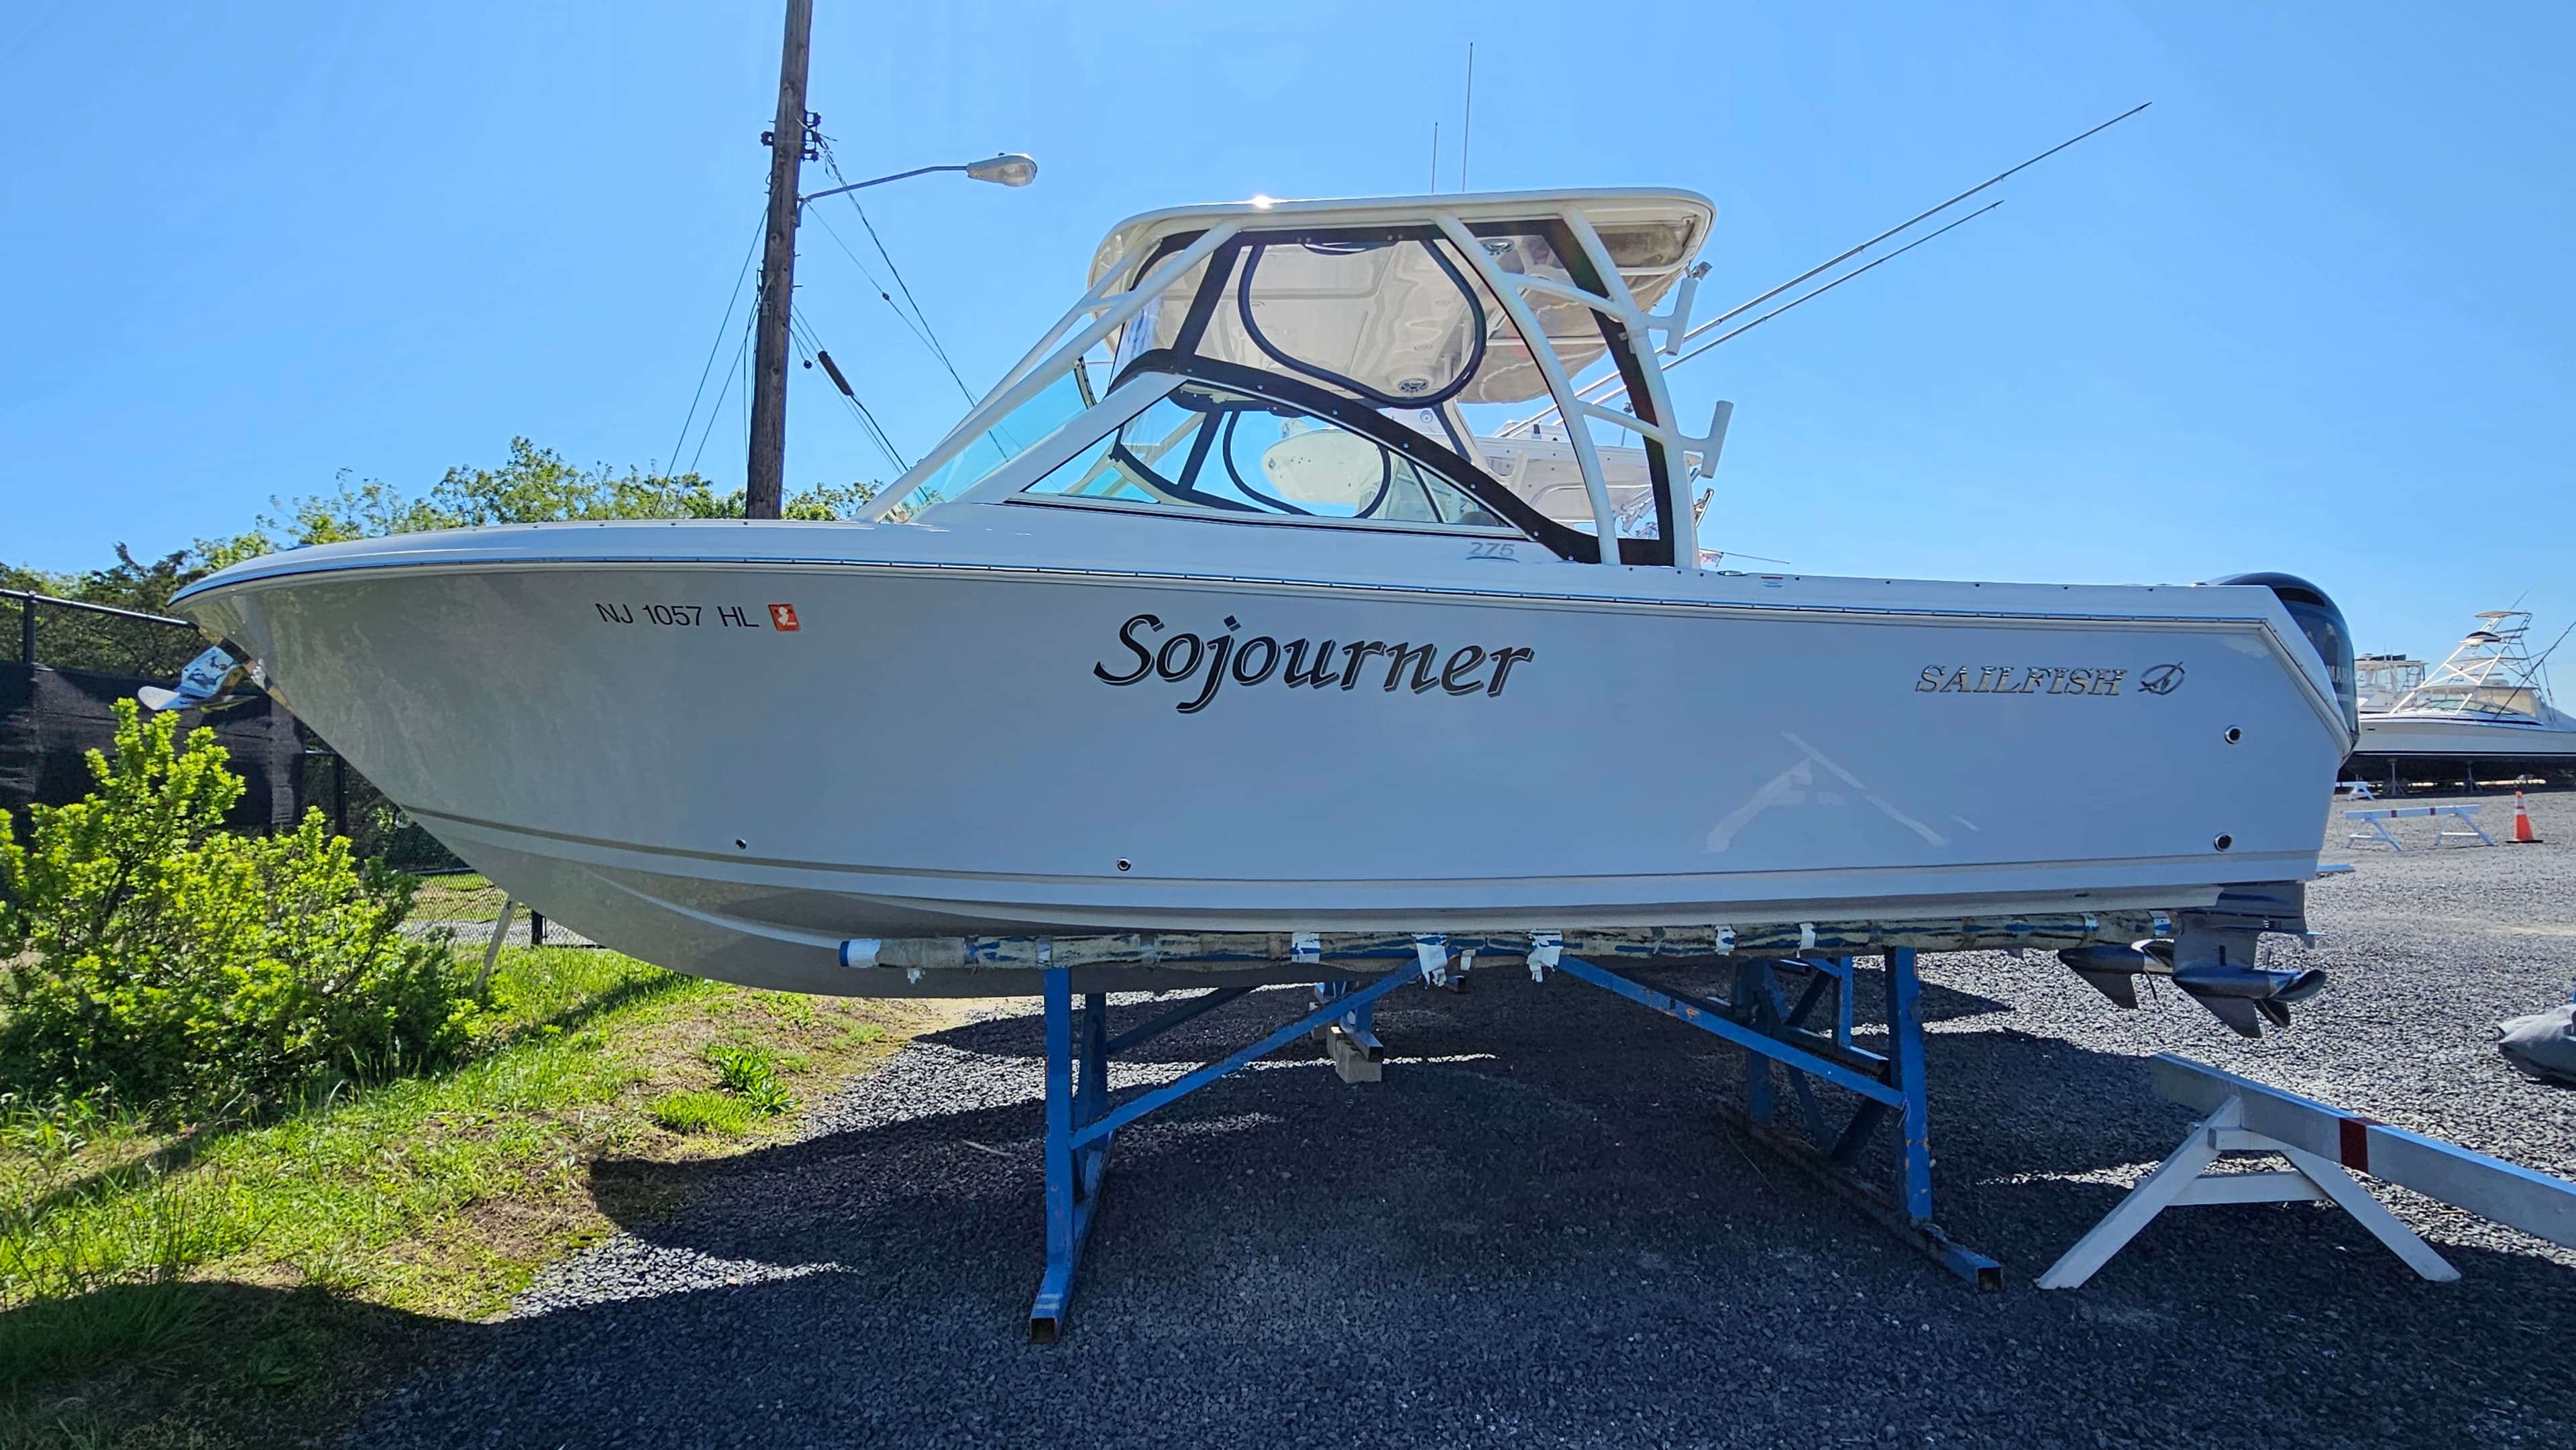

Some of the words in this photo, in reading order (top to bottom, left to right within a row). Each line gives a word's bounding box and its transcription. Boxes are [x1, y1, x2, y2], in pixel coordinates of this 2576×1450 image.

[1469, 542, 1515, 556] 275
[596, 604, 634, 624] NJ
[642, 605, 702, 626] 1057
[717, 606, 759, 627] HL
[1093, 614, 1534, 714] Sojourner
[1915, 664, 2128, 696] SAILFISH
